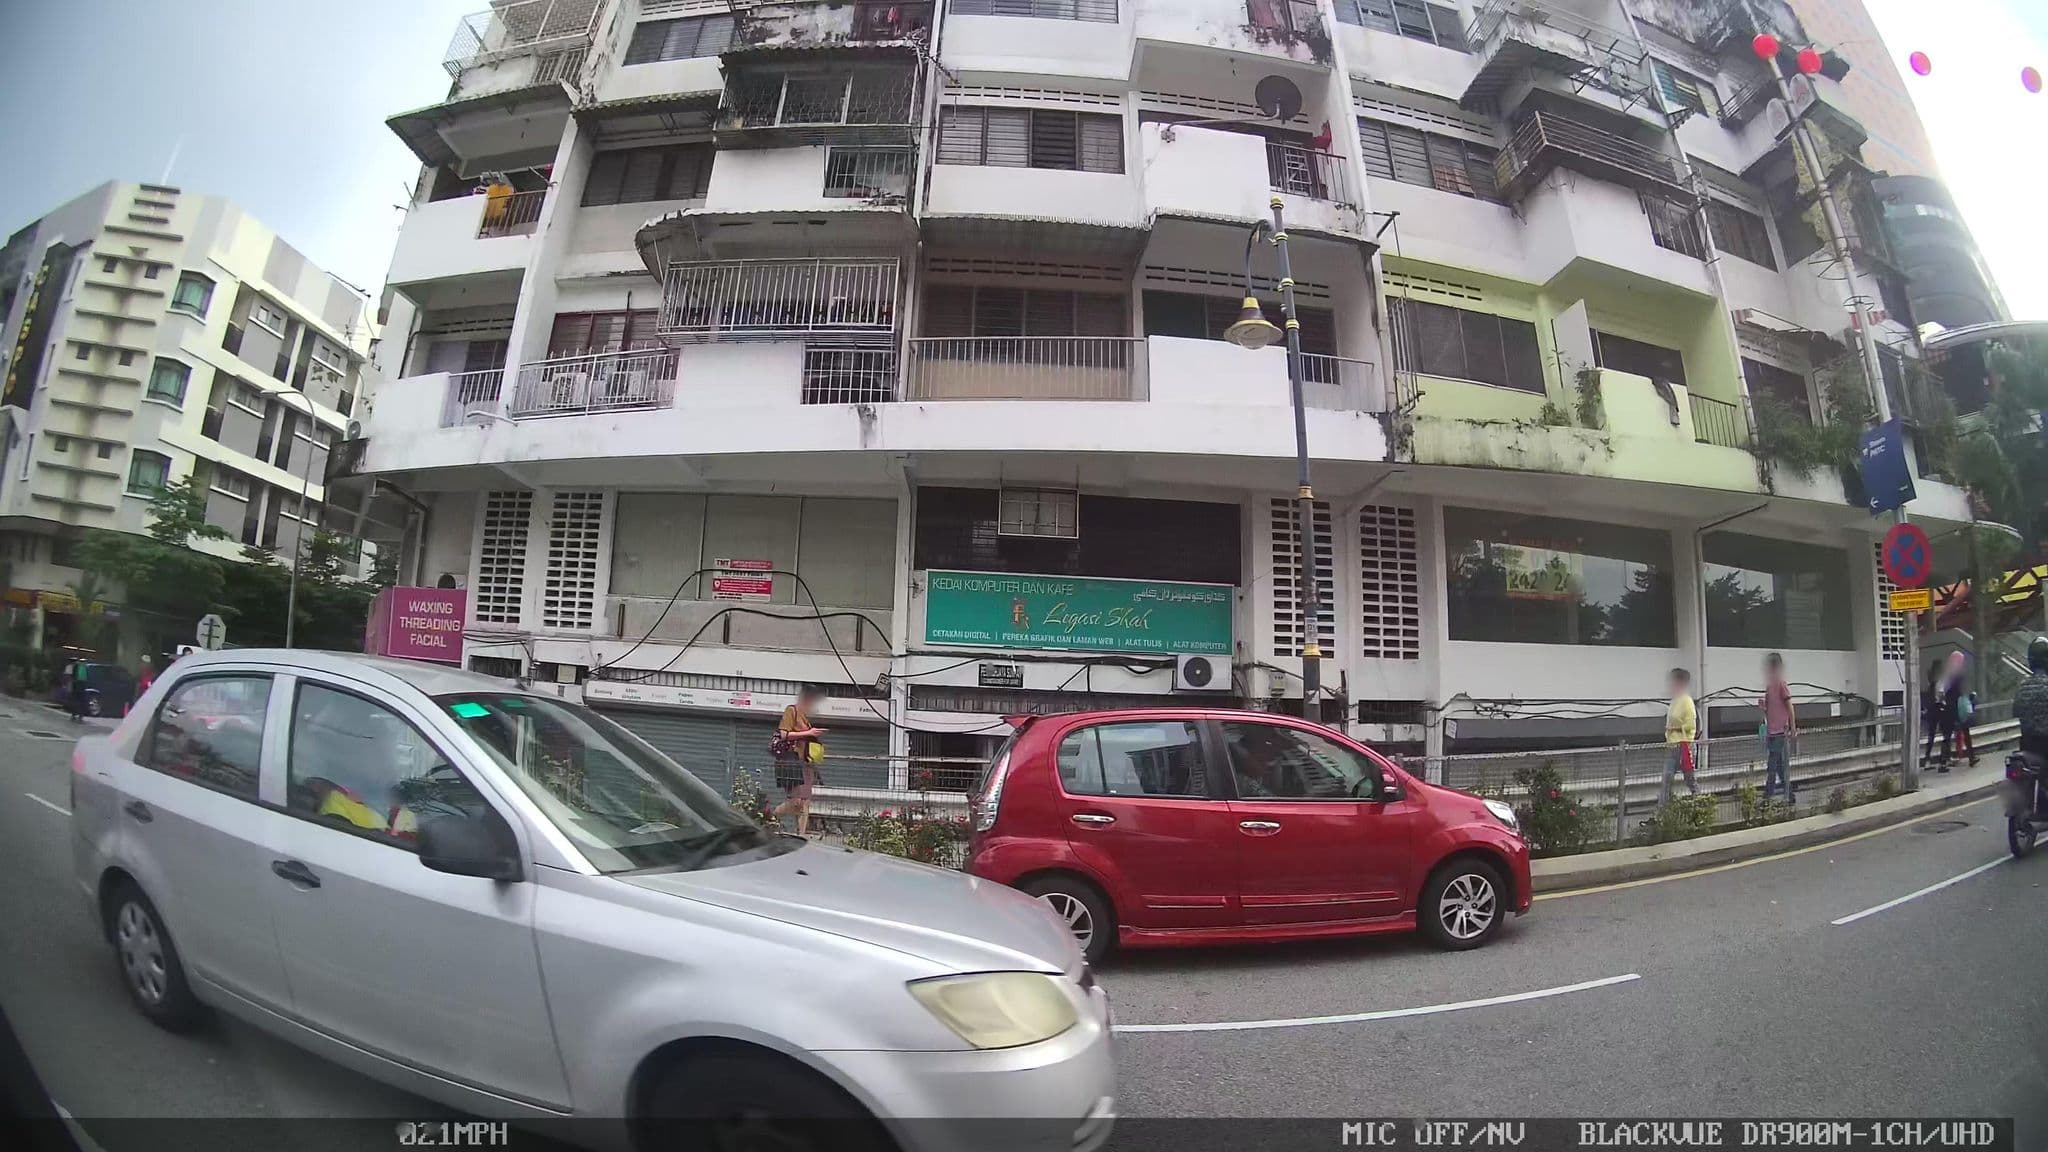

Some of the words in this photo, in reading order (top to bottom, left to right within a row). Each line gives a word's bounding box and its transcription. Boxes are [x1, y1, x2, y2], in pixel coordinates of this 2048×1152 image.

[932, 578, 962, 590] KEDAI
[964, 579, 1020, 593] KOMPUTER
[1022, 581, 1046, 594] DAN
[1047, 583, 1073, 596] KAFE
[408, 601, 453, 614] WAXING
[399, 616, 461, 632] THREADING
[1042, 602, 1103, 634] Legasi
[1104, 607, 1153, 630] Shah
[410, 633, 447, 648] FACIAL
[932, 629, 963, 639] CETAKAN
[964, 631, 991, 640] DIGITAL
[1002, 632, 1029, 641] PEREKA
[1057, 635, 1072, 644] DAN
[1098, 637, 1114, 646] WEB
[1124, 638, 1141, 647] ALAT
[1143, 639, 1162, 648] TULIS
[1172, 640, 1189, 649] ALAT
